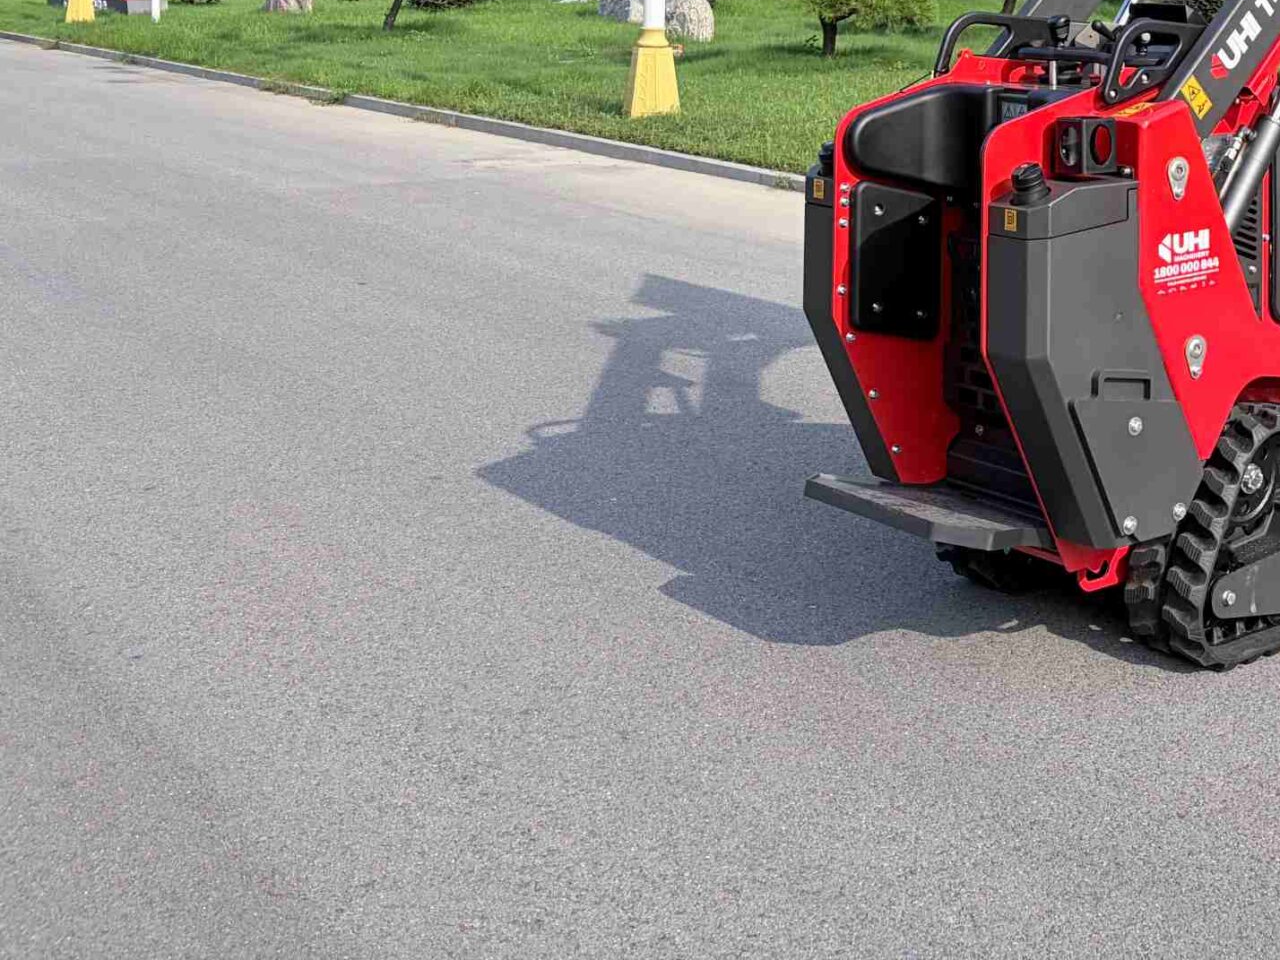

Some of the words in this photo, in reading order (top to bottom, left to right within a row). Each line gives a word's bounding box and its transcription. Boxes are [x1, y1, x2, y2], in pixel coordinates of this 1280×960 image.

[1217, 10, 1262, 70] UHI
[1173, 228, 1210, 254] UHI
[1154, 264, 1180, 279] 1800
[1180, 260, 1200, 274] 000
